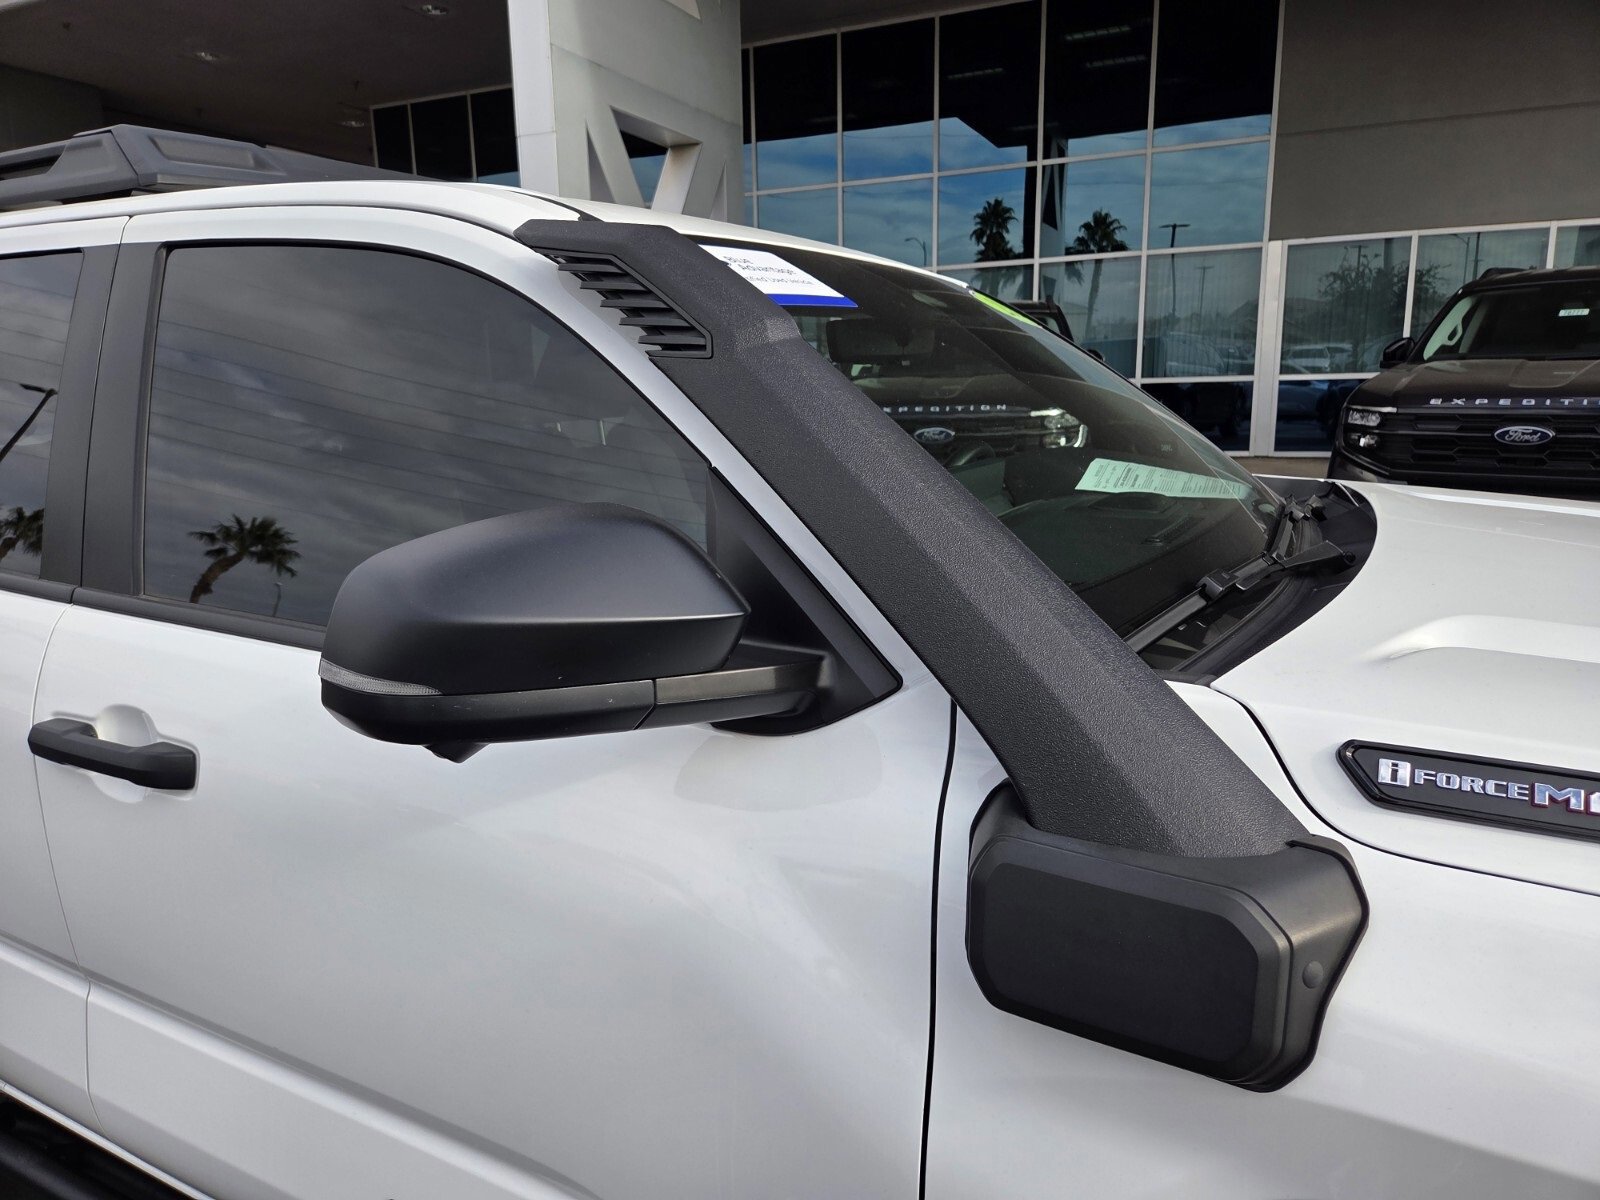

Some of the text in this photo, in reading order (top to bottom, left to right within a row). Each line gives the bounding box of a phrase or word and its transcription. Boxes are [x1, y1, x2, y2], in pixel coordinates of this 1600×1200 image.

[1429, 397, 1600, 406] EXPEDITI
[882, 403, 1007, 413] XPEDITION
[1414, 768, 1530, 801] FORCE
[1532, 782, 1600, 816] M
